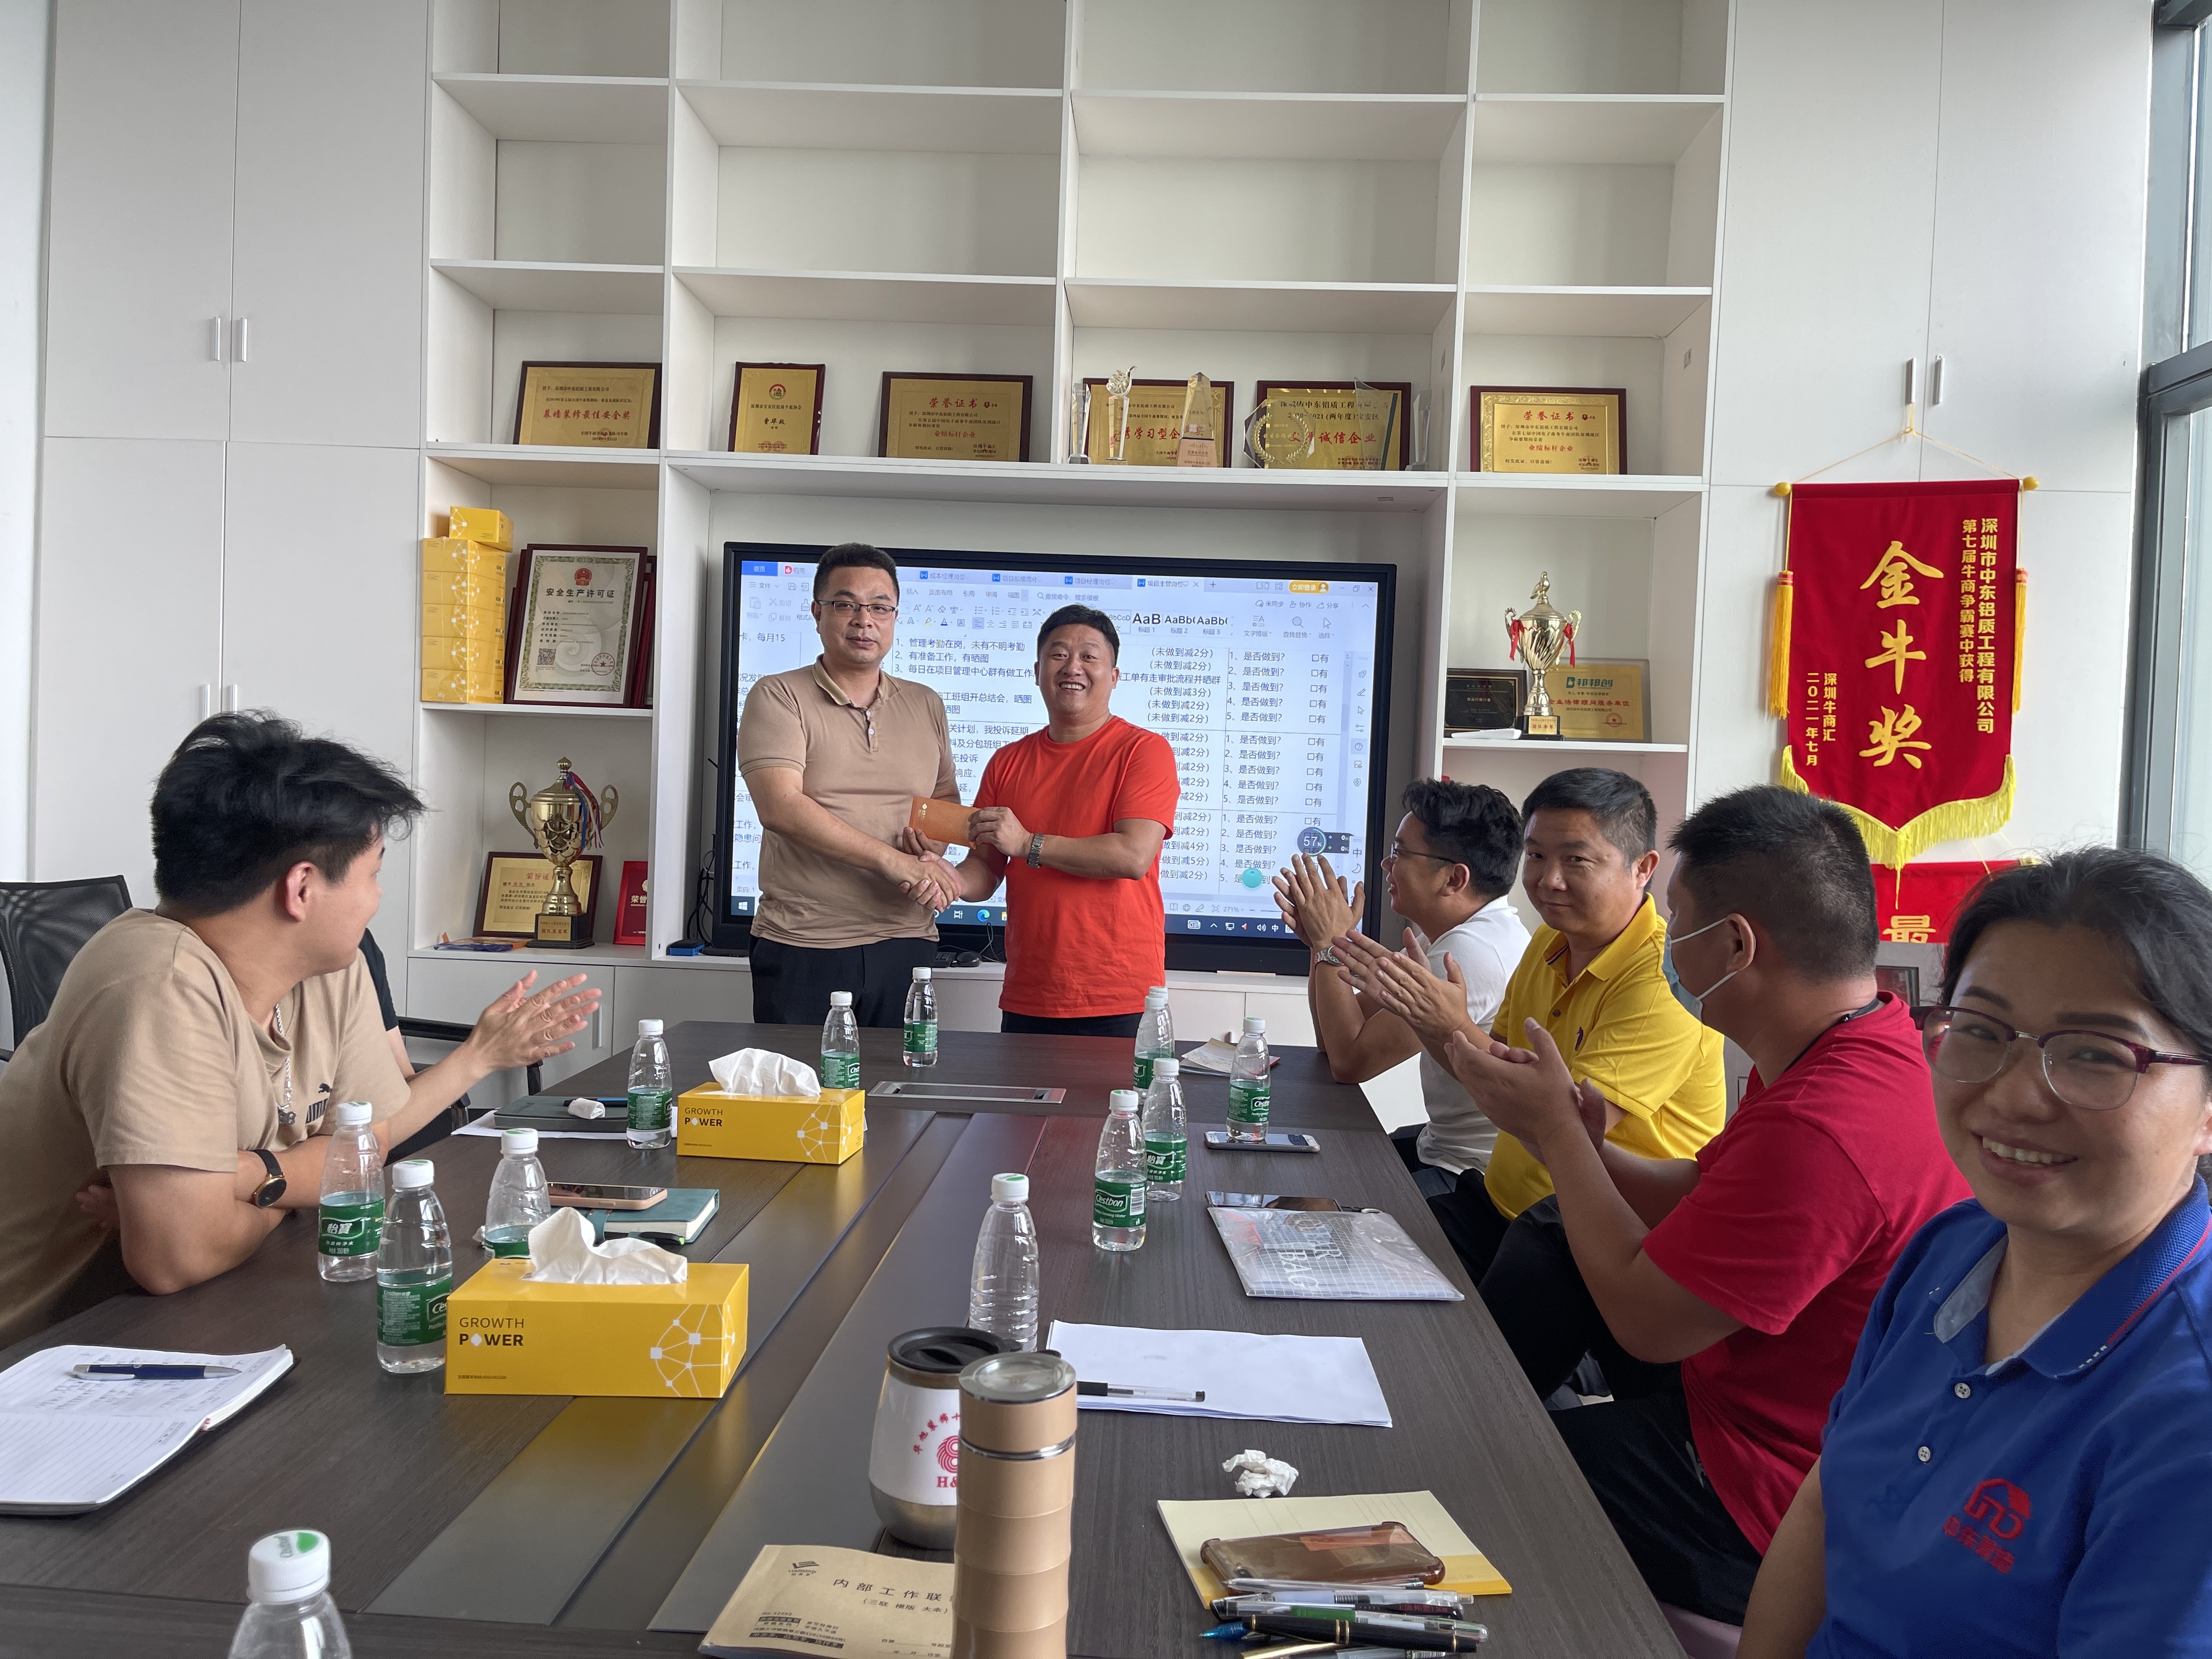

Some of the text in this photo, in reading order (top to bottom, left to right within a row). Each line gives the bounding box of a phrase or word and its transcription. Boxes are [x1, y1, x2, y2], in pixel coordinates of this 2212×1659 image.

[929, 397, 978, 409] 荣誉证书
[1523, 410, 1574, 421] 荣誉证书
[546, 588, 614, 598] 安全生产许可证
[1959, 518, 1977, 682] 第七届牛商争霸赛中获得
[1132, 613, 1161, 624] AaB
[1977, 518, 1998, 733] 深圳市中东铝质工程有限公司
[1859, 540, 1944, 769] 金牛奖
[1823, 673, 1837, 742] 深圳牛商汇
[1155, 732, 1209, 743] 做到减2分）
[1178, 777, 1209, 787] 减2分）
[733, 833, 761, 843] 隐患问
[1353, 848, 1362, 857] 中
[1883, 915, 1936, 944] 最
[685, 1107, 723, 1116] GROWTH
[1278, 1250, 1318, 1288] BAG
[459, 1317, 524, 1329] GROWTH
